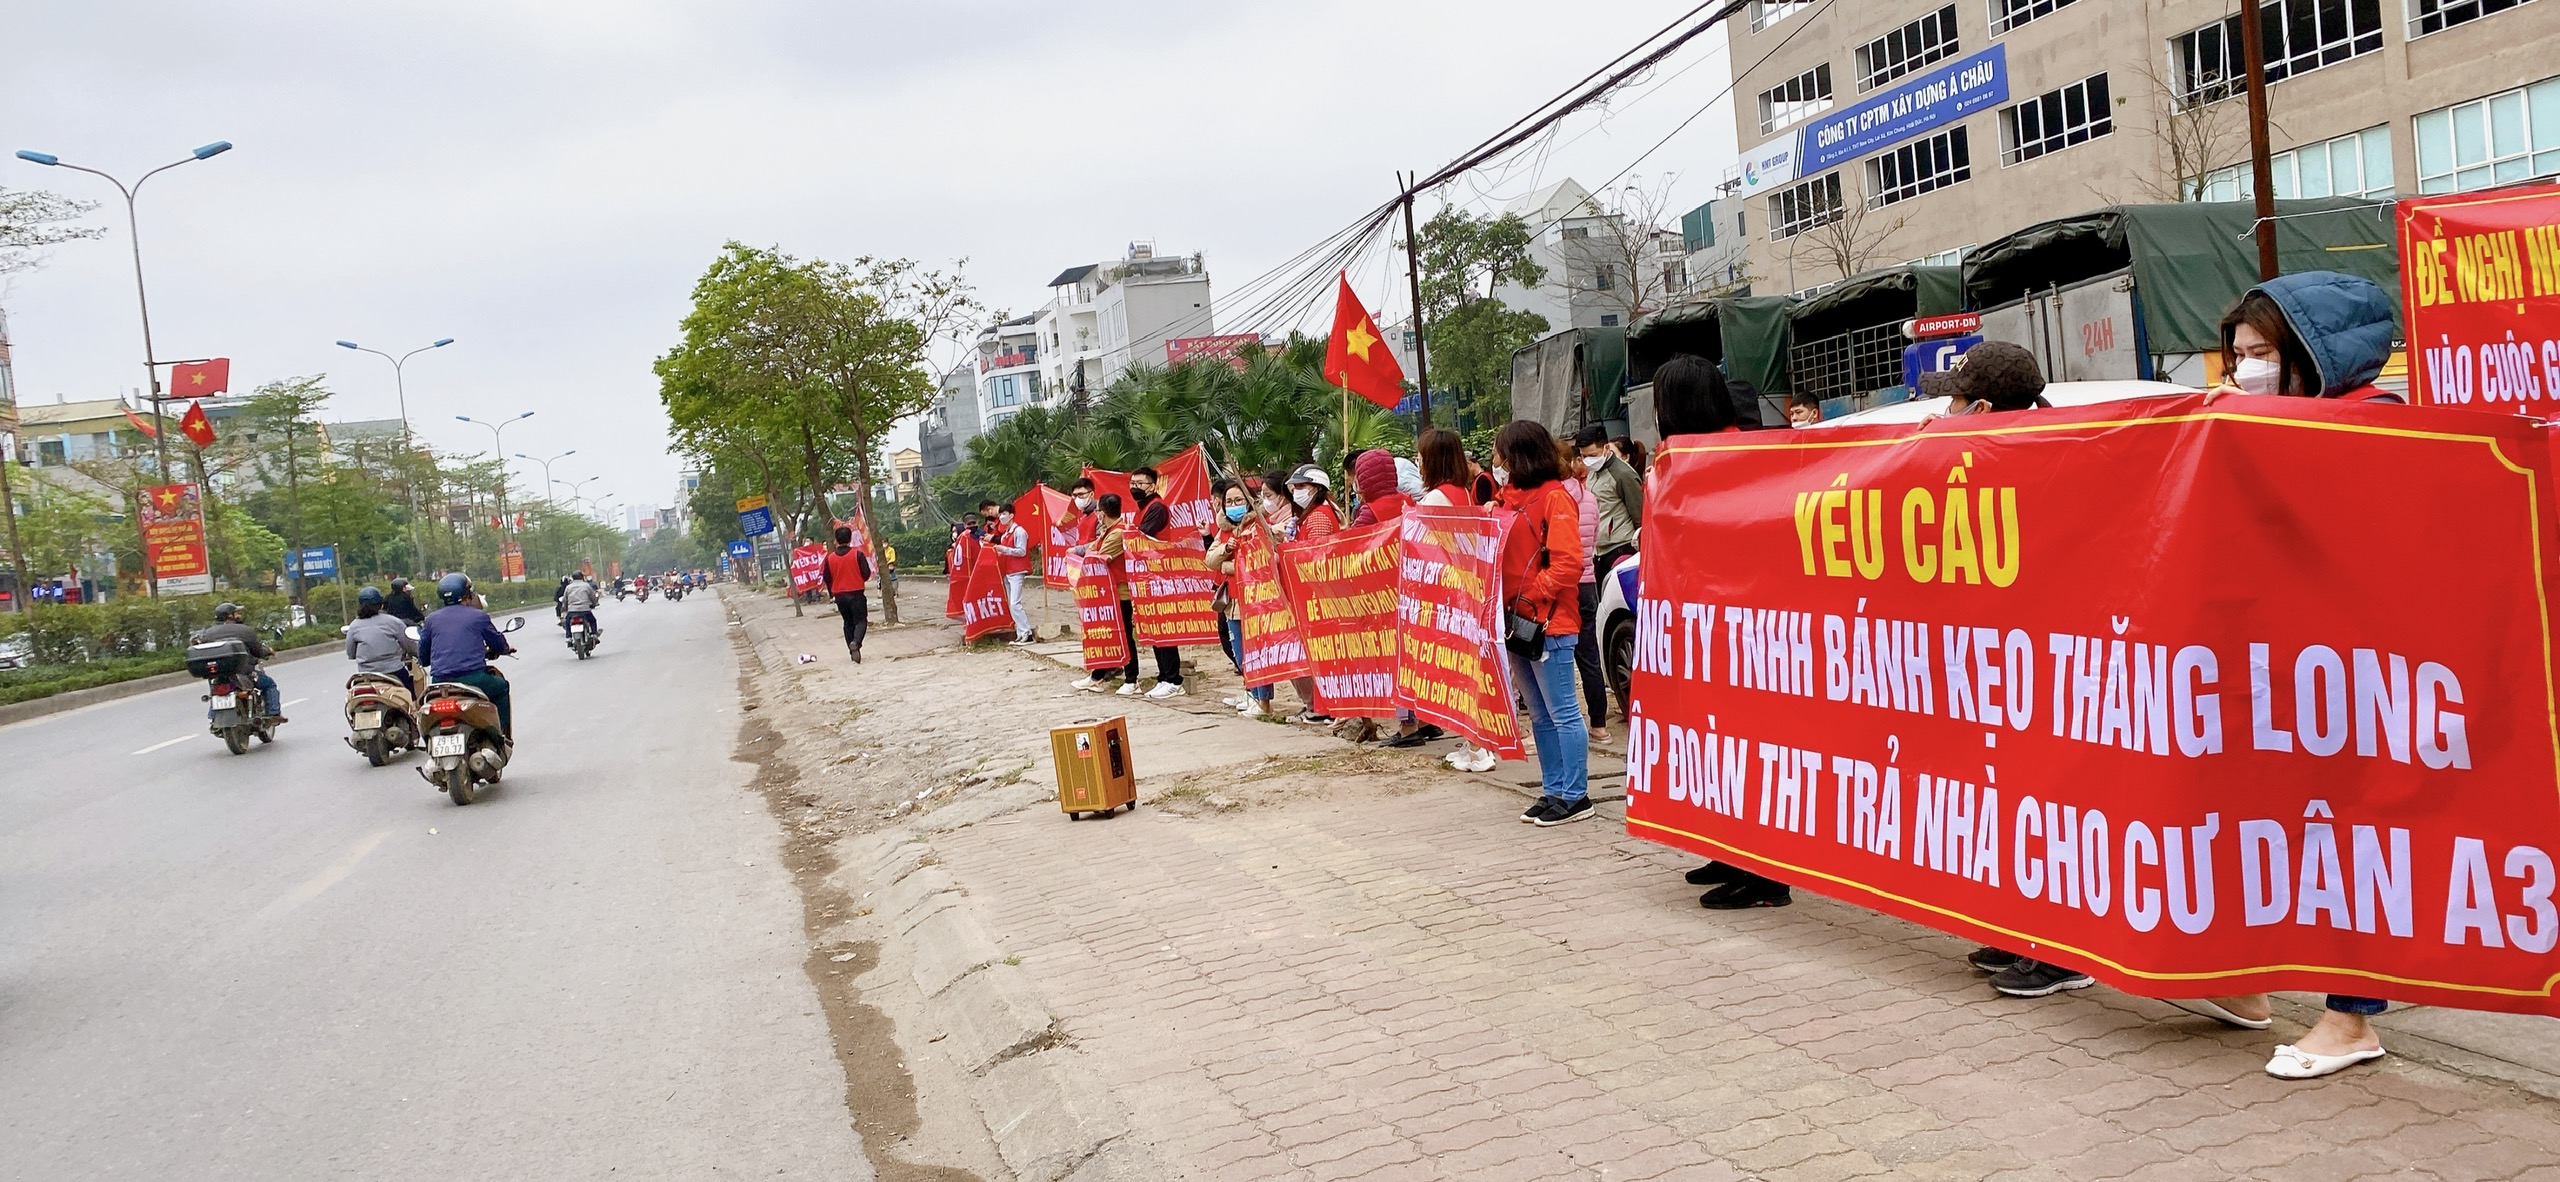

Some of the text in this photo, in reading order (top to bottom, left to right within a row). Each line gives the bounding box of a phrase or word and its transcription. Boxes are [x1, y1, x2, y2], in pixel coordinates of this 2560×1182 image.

[1818, 60, 1994, 149] CÔNG TY CPTM XÂY DỰNG Á CHÂU
[1771, 150, 1790, 167] GROUP
[2415, 216, 2455, 307] ĐỀ
[2454, 229, 2526, 315] NGHỊ
[1919, 316, 1977, 334] AIRPORT-DN
[2083, 316, 2115, 356] 24H
[2425, 333, 2474, 406] VÀO
[2479, 329, 2541, 415] CUỘC
[1793, 452, 2020, 588] YÊU CẦU
[976, 589, 1005, 620] KẾT
[1099, 605, 1115, 621] CITY
[1306, 591, 1321, 622] ĐỀ
[1084, 645, 1122, 659] NEW CITY
[1420, 641, 1436, 665] CƠ
[1435, 645, 1459, 672] QUAN
[1681, 602, 1716, 683] TY
[1724, 605, 1814, 698] TNHH
[1823, 597, 1935, 716] BÁNH
[1942, 624, 2034, 748] KẸO
[2049, 616, 2224, 759] THĂNG
[2249, 642, 2473, 771] LONG
[434, 744, 462, 756] 670.37
[1667, 714, 1749, 820] ĐOÀN
[1758, 742, 1823, 837] THT
[1832, 734, 1901, 861] TRẢ
[1913, 764, 2000, 888] NHÀ
[2014, 795, 2111, 918] CHO
[2123, 812, 2220, 934] CƯ
[2239, 799, 2414, 938] DÂN
[2443, 836, 2560, 954] A3
